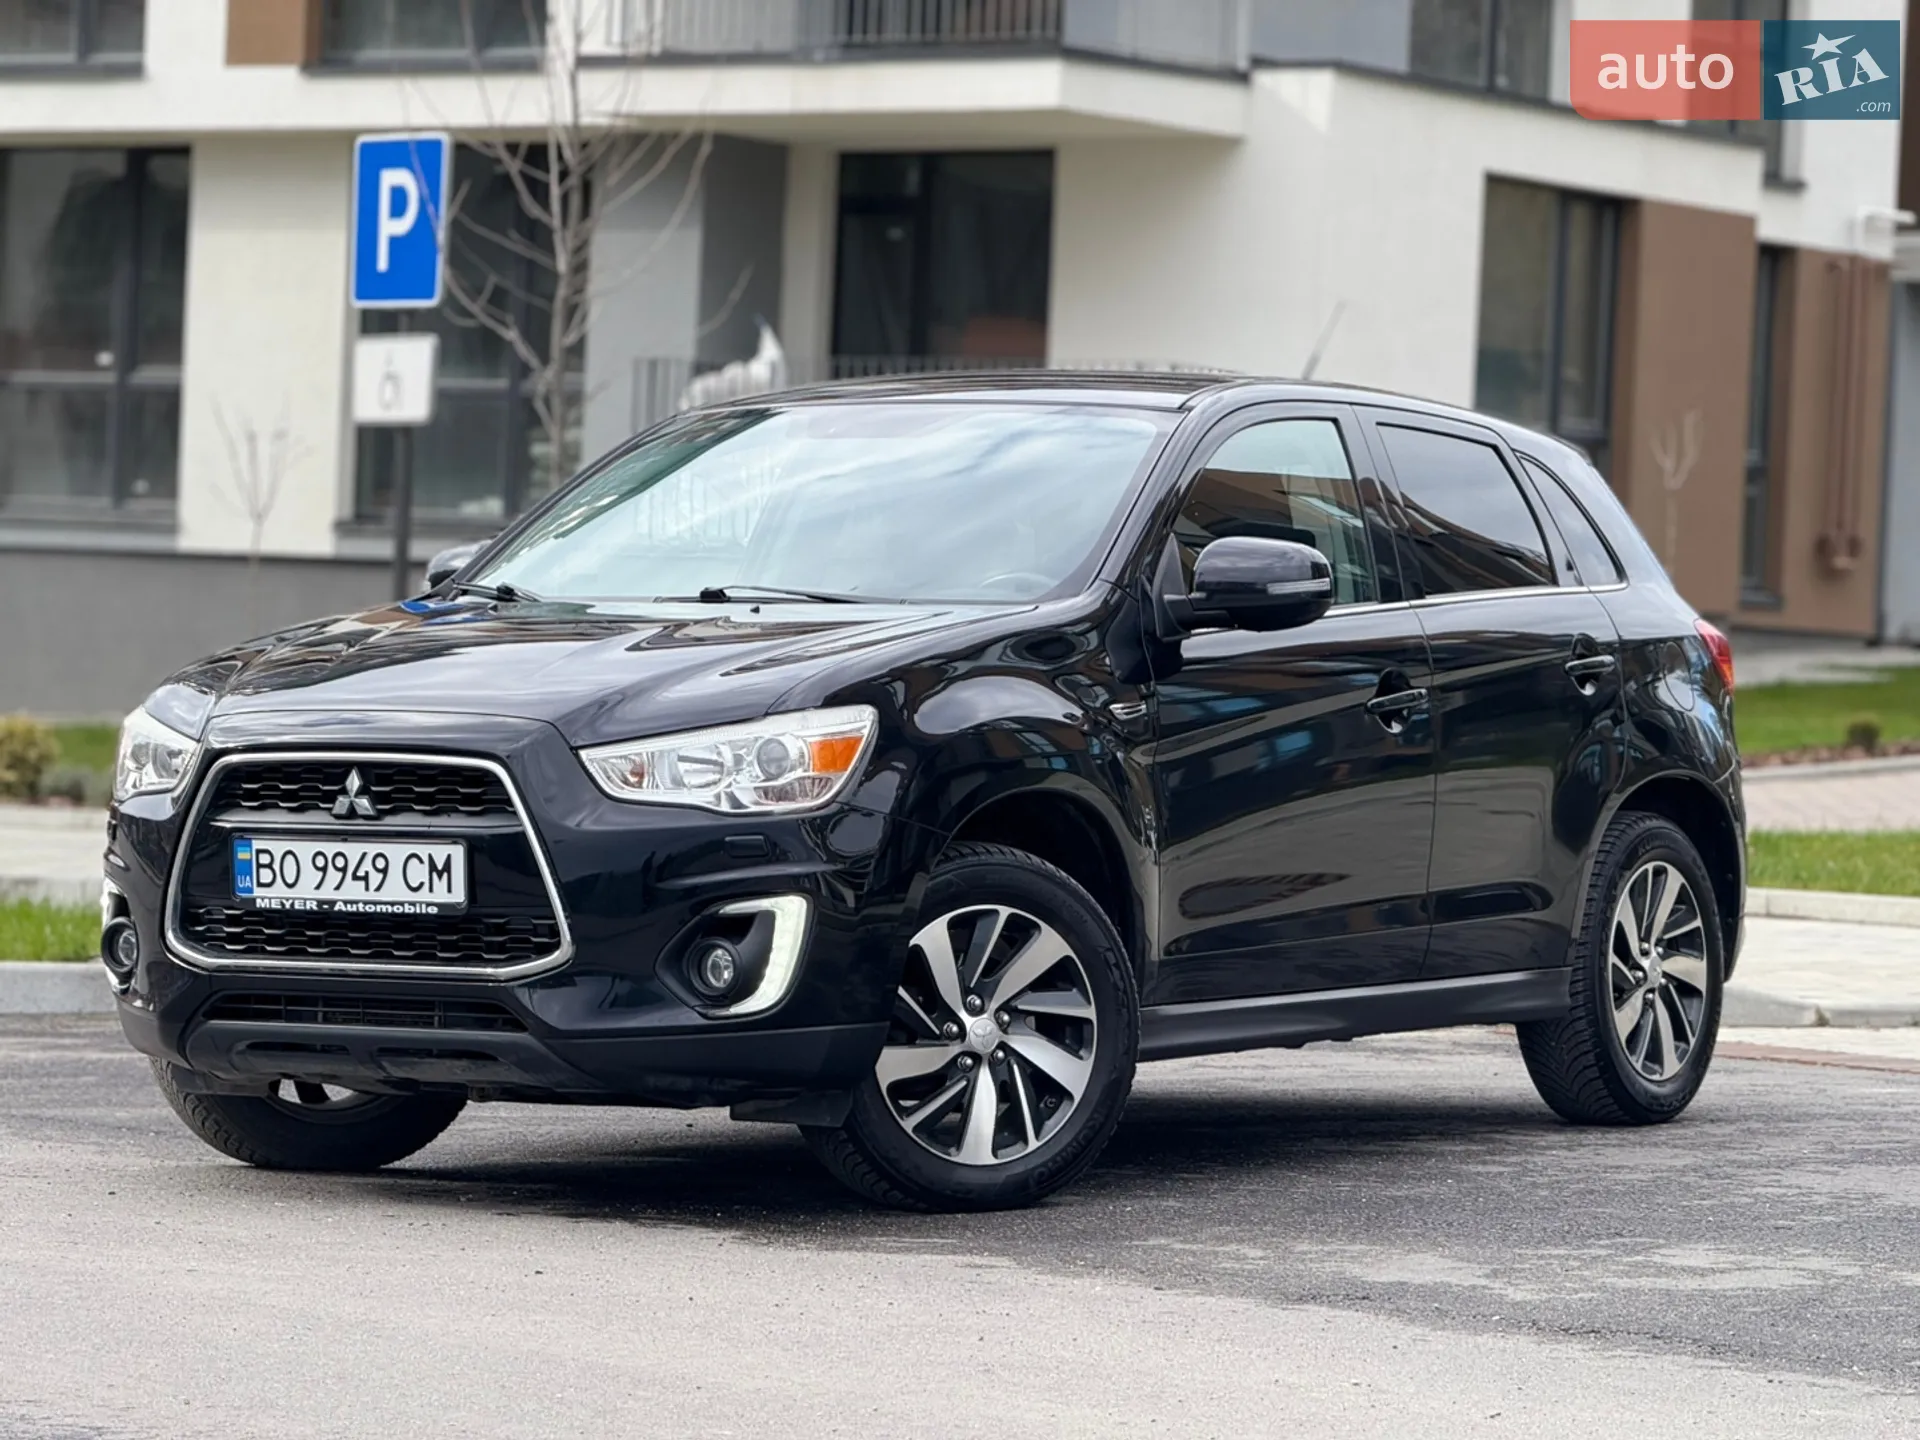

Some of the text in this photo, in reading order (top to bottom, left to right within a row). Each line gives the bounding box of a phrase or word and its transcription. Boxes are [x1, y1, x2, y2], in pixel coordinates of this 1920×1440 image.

[376, 167, 420, 274] P
[237, 875, 252, 888] UA
[255, 848, 453, 893] BO 9949 CM
[256, 898, 318, 910] MEYER
[333, 900, 439, 914] Automobile
